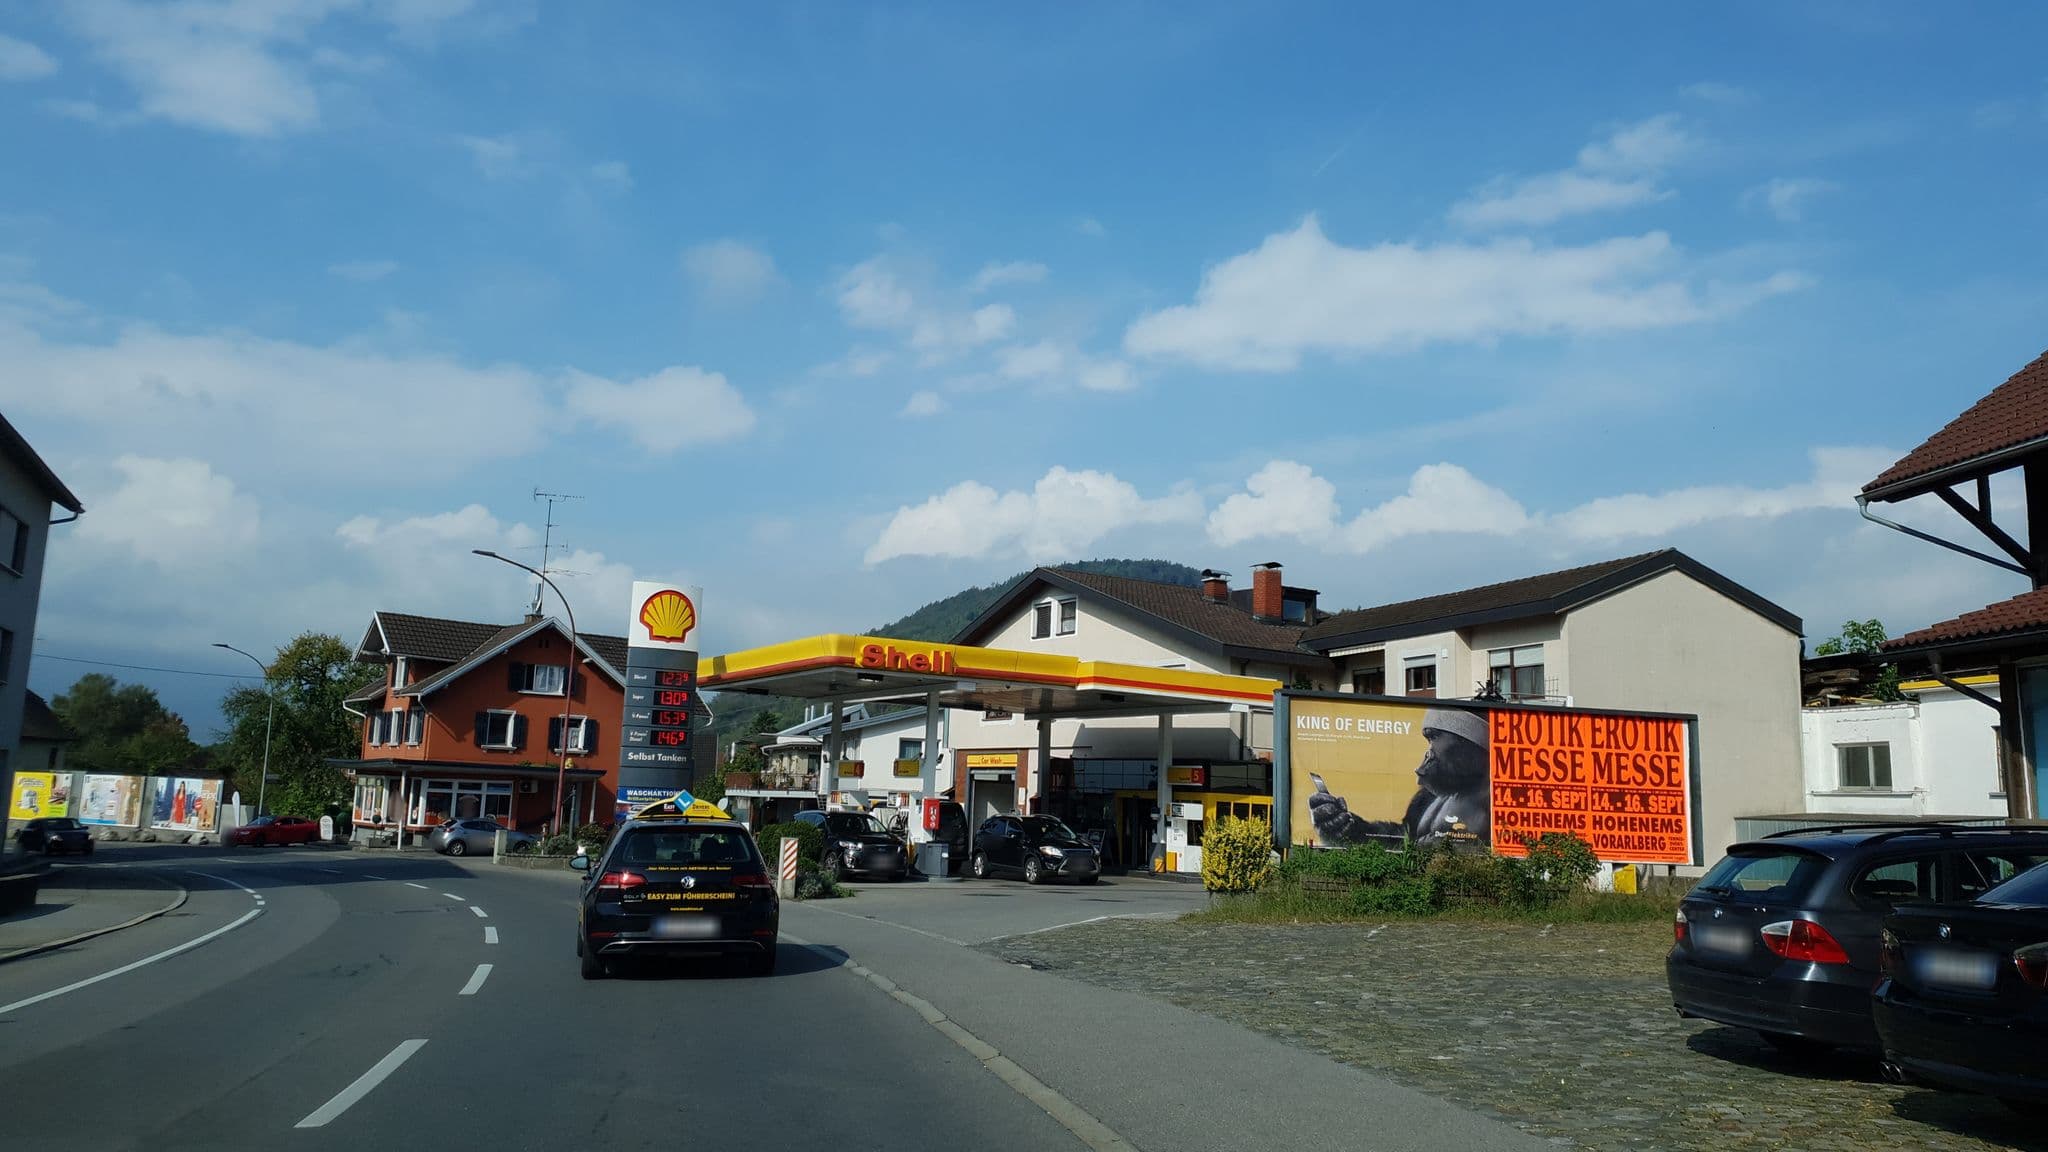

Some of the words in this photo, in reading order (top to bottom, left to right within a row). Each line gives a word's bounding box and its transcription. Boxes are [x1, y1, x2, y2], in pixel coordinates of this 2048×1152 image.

[863, 645, 954, 673] Shell
[1297, 715, 1330, 730] KING
[1335, 718, 1352, 731] OF
[1358, 719, 1411, 735] ENERGY
[1493, 711, 1584, 747] EROTIK
[1591, 716, 1680, 752] EROTIK
[628, 752, 655, 760] Selbst
[657, 754, 687, 762] Tanken
[1494, 746, 1585, 782] MESSE
[1192, 770, 1200, 782] 5
[1591, 752, 1682, 787] MESSE
[1495, 787, 1516, 806] 14.
[1527, 789, 1548, 808] 16.
[1551, 790, 1586, 809] SEPT
[1592, 792, 1614, 811] 14.
[1624, 794, 1645, 812] 16.
[1648, 795, 1683, 814] SEPT
[1495, 811, 1586, 830] HOHENEMS
[1592, 815, 1683, 833] HOHENEMS
[1593, 834, 1666, 851] VORARLBERG
[647, 892, 665, 900] EASY
[667, 892, 681, 900] ZUM
